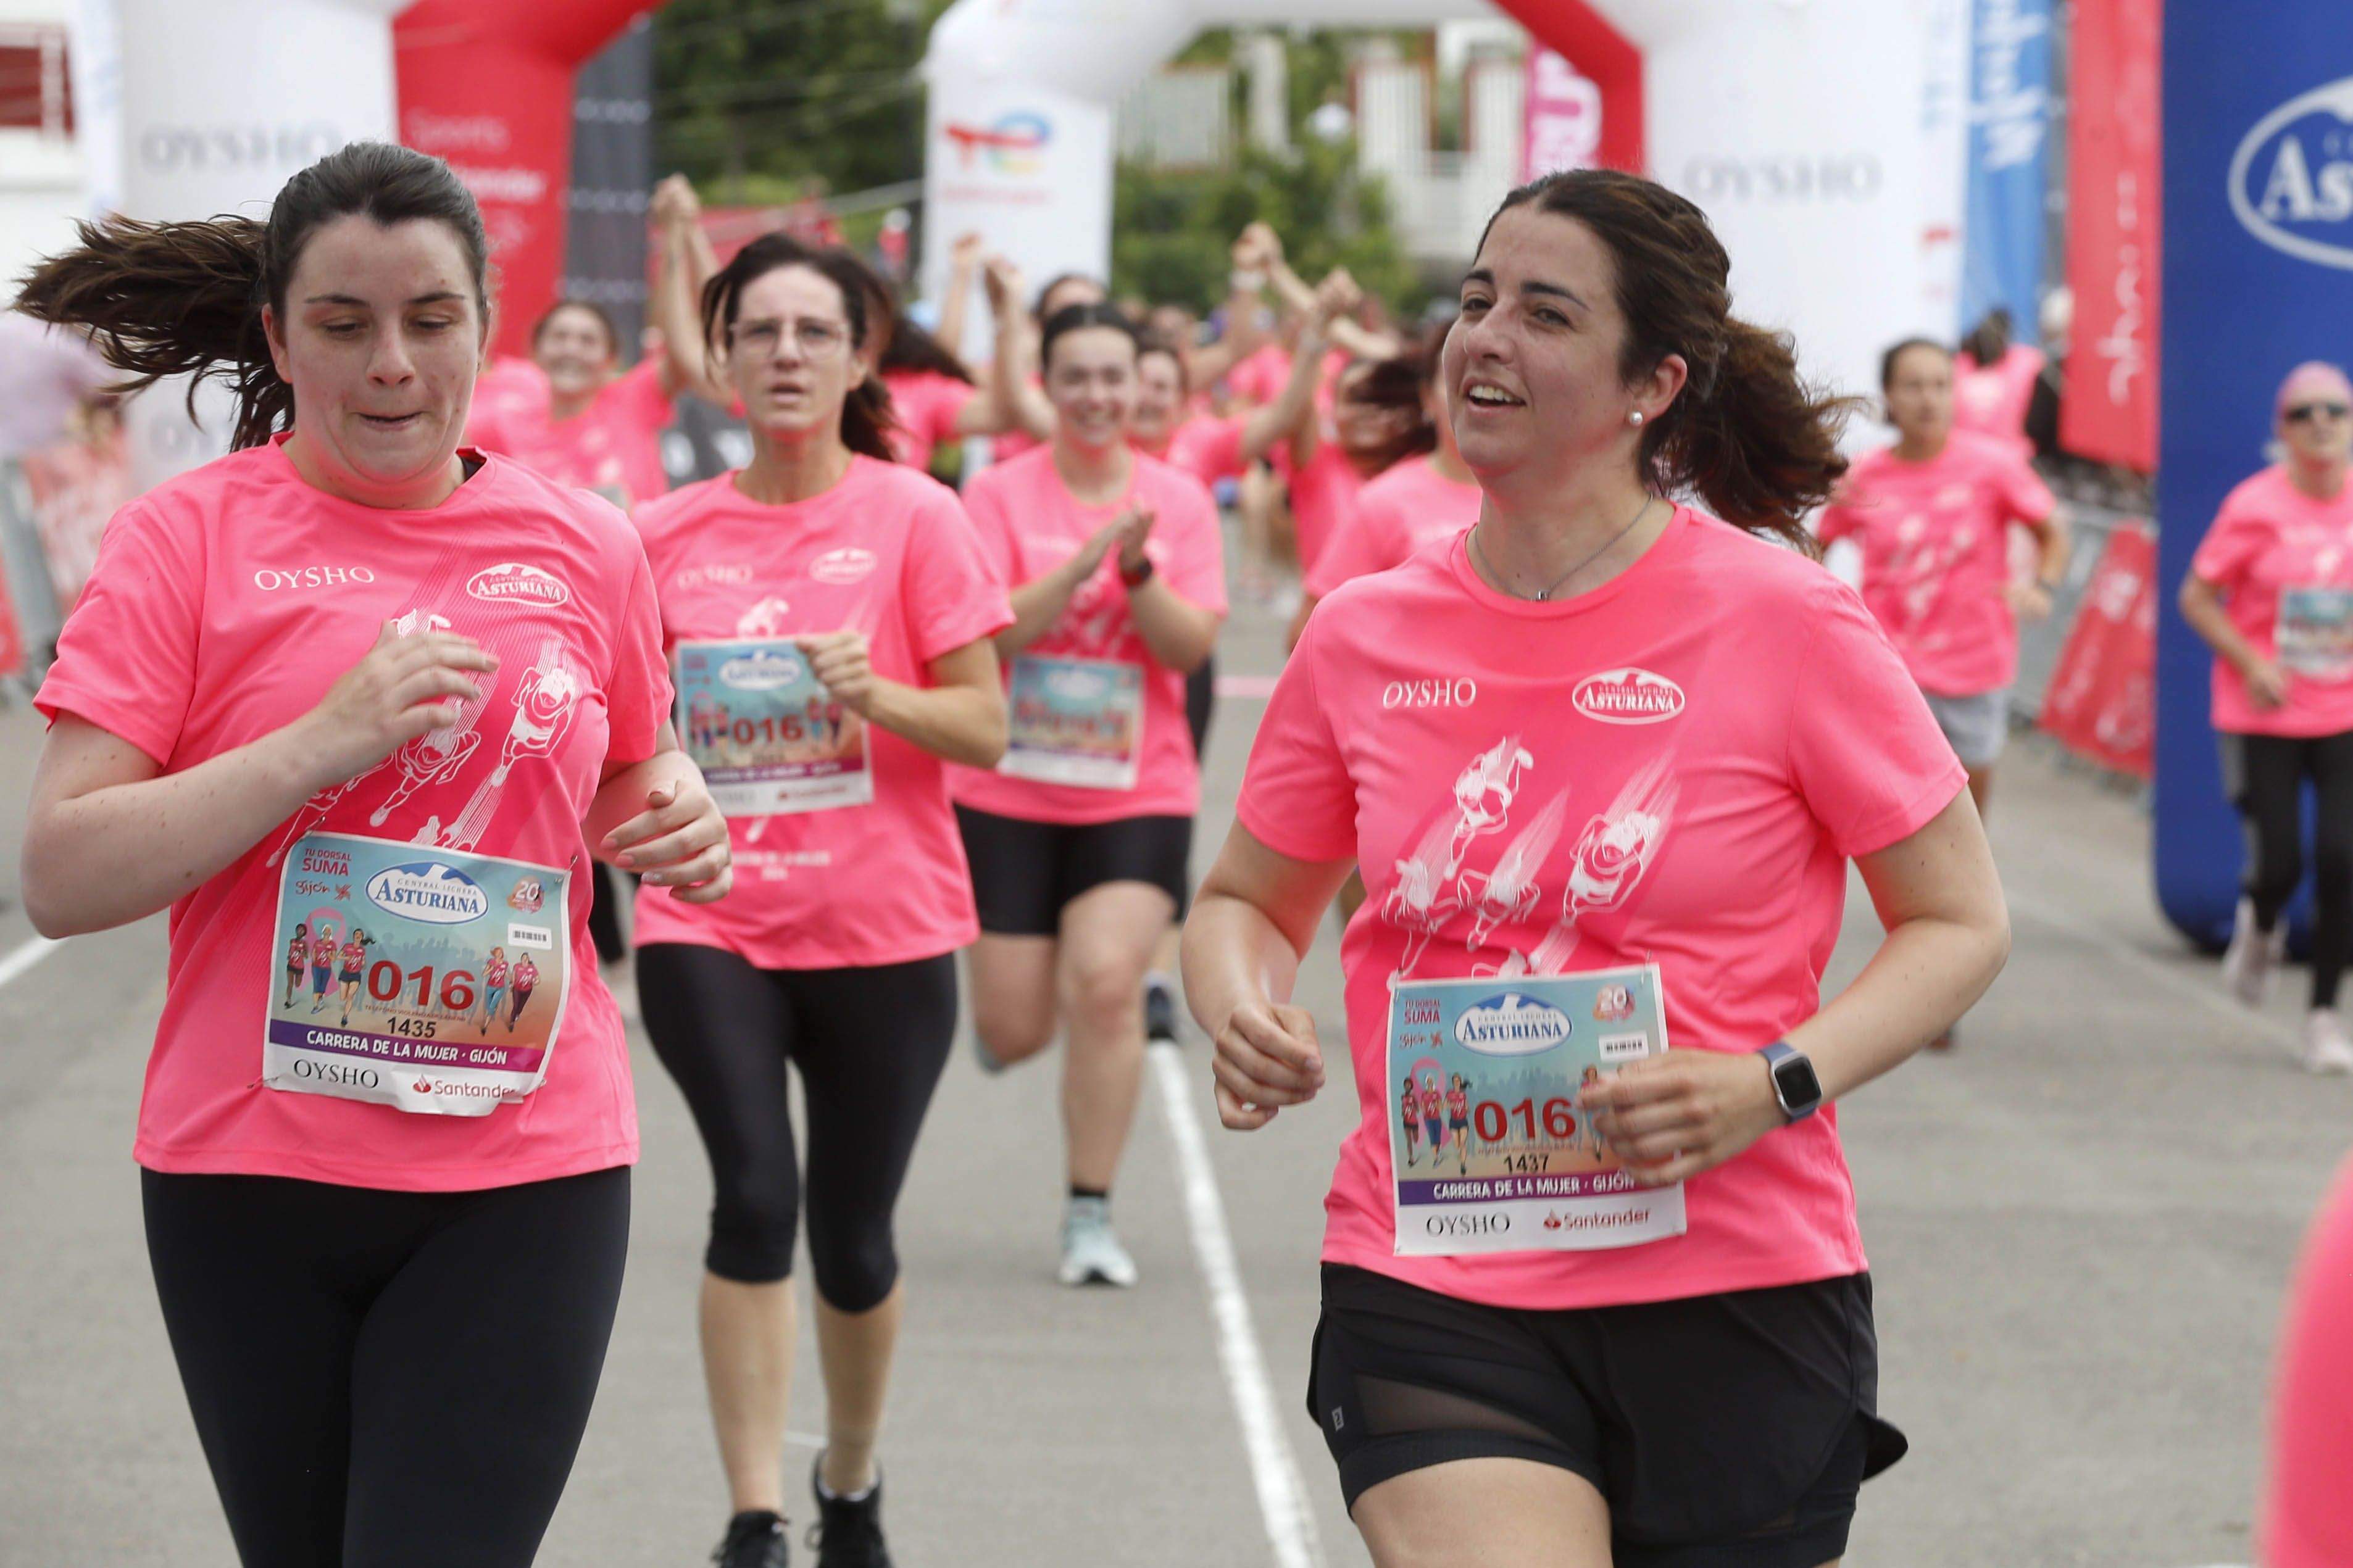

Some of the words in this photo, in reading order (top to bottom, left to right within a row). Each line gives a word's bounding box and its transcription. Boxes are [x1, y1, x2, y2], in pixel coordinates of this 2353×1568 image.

[254, 566, 375, 591] OYSHO
[477, 579, 561, 601] ASTURIANA
[1383, 677, 1476, 710] OYSHO
[1580, 684, 1675, 712] ASTURIANA
[733, 715, 803, 745] 016
[302, 857, 349, 877] SUMA
[305, 848, 315, 857] TU
[317, 849, 351, 861] DORSAL
[375, 877, 480, 914] ASTURIANA
[514, 880, 541, 902] 20
[367, 960, 475, 1011] 016
[387, 1016, 437, 1038] 1435
[1404, 1008, 1441, 1024] SUMA
[1463, 1017, 1562, 1043] ASTURIANA
[307, 1030, 369, 1052] CARRERA
[373, 1039, 390, 1054] DE
[393, 1042, 411, 1057] LA
[415, 1045, 457, 1061] MUJER
[470, 1047, 507, 1065] GIJÓN
[294, 1059, 379, 1089] OYSHO
[435, 1080, 515, 1099] Santande
[1473, 1096, 1576, 1142] 016
[1503, 1153, 1550, 1174] 1437
[1433, 1182, 1491, 1200] CARRERA
[1495, 1179, 1514, 1197] DE
[1517, 1177, 1535, 1196] LA
[1536, 1175, 1580, 1195] MUJER
[1426, 1211, 1510, 1238] OYSHO
[1563, 1206, 1651, 1231] Santander
